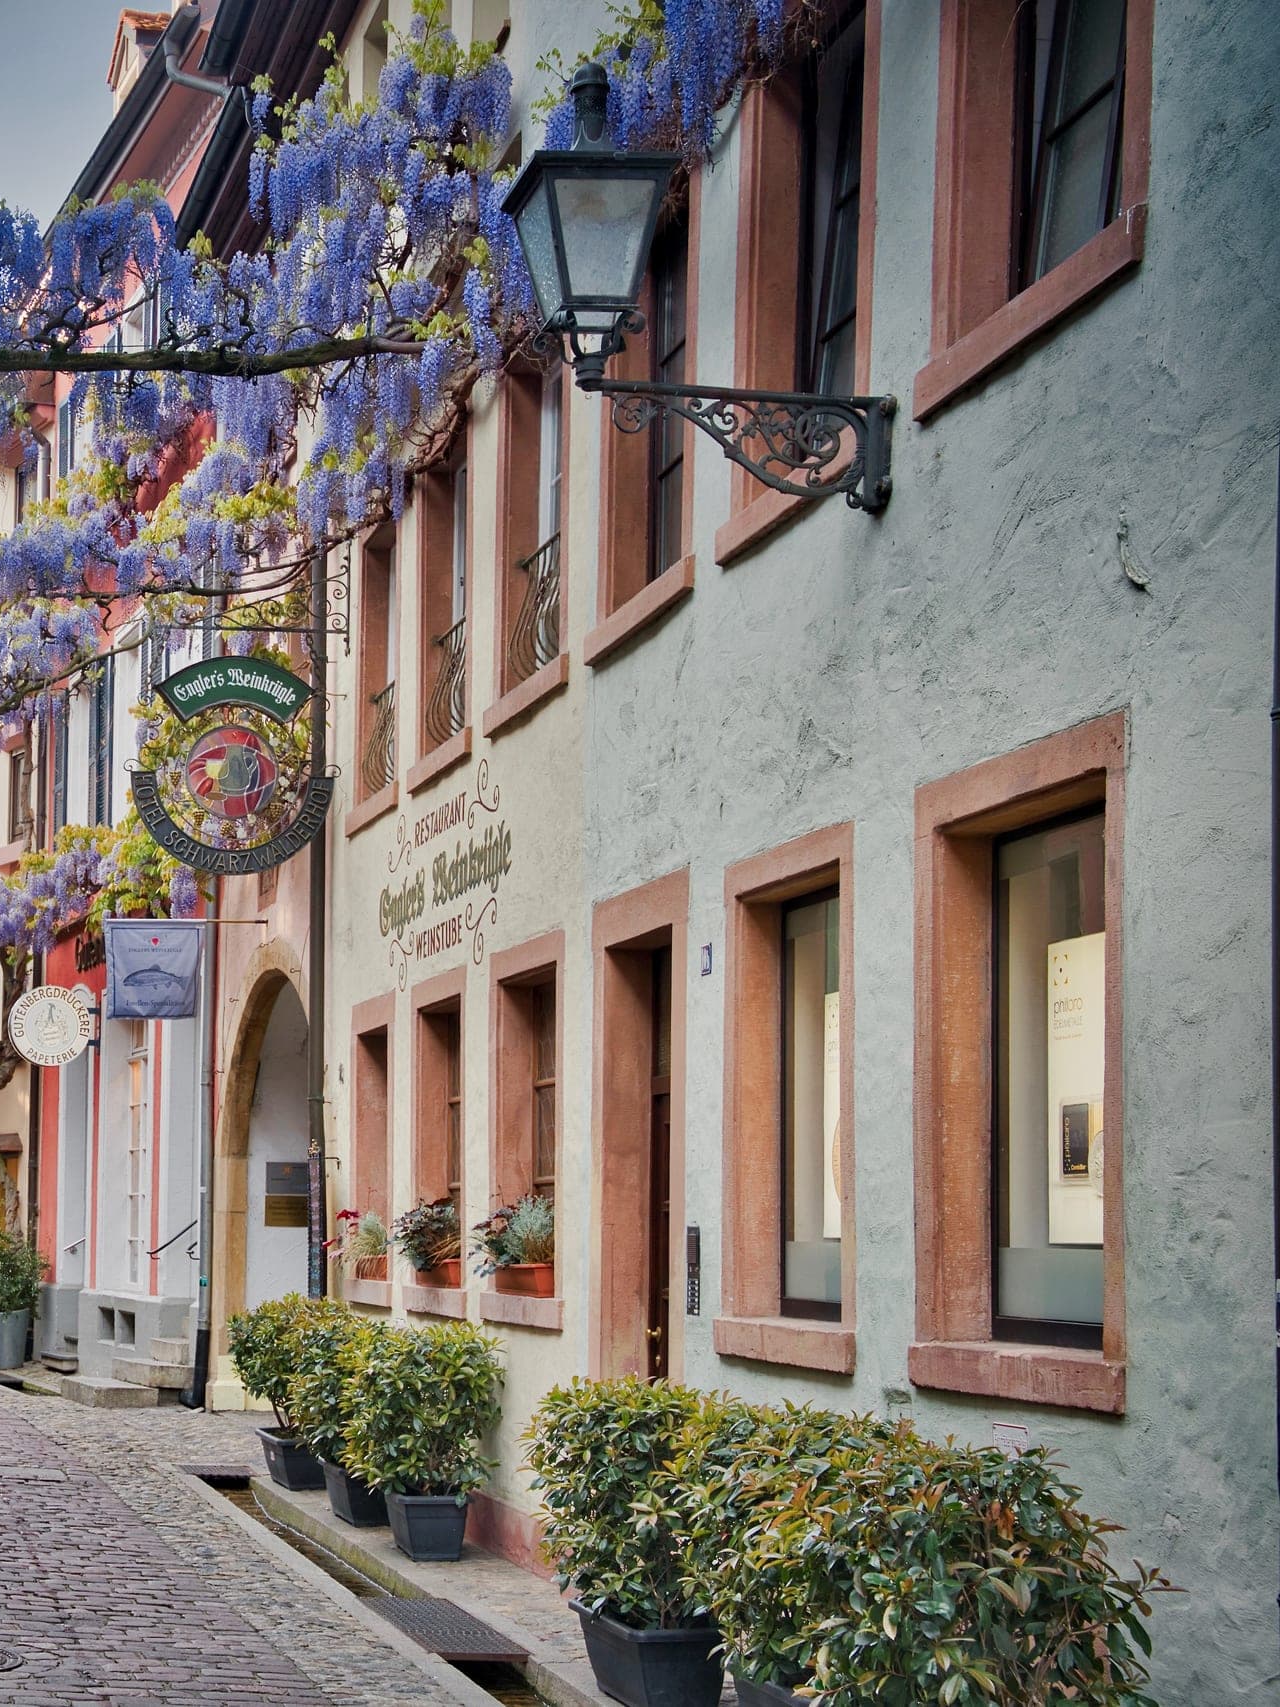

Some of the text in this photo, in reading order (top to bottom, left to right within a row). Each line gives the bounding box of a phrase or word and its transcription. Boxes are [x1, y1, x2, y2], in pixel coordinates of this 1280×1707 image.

[173, 667, 297, 706] Engler's Weinkrügle
[134, 773, 162, 832] HOTEL
[414, 791, 467, 849] RESTAURANT
[379, 819, 513, 941] Engler's Weinkrügle
[415, 914, 463, 962] WEINSTUBE
[12, 987, 90, 1038] GUTENBERGDRUCKEREI
[26, 1047, 78, 1065] PAPETERIE
